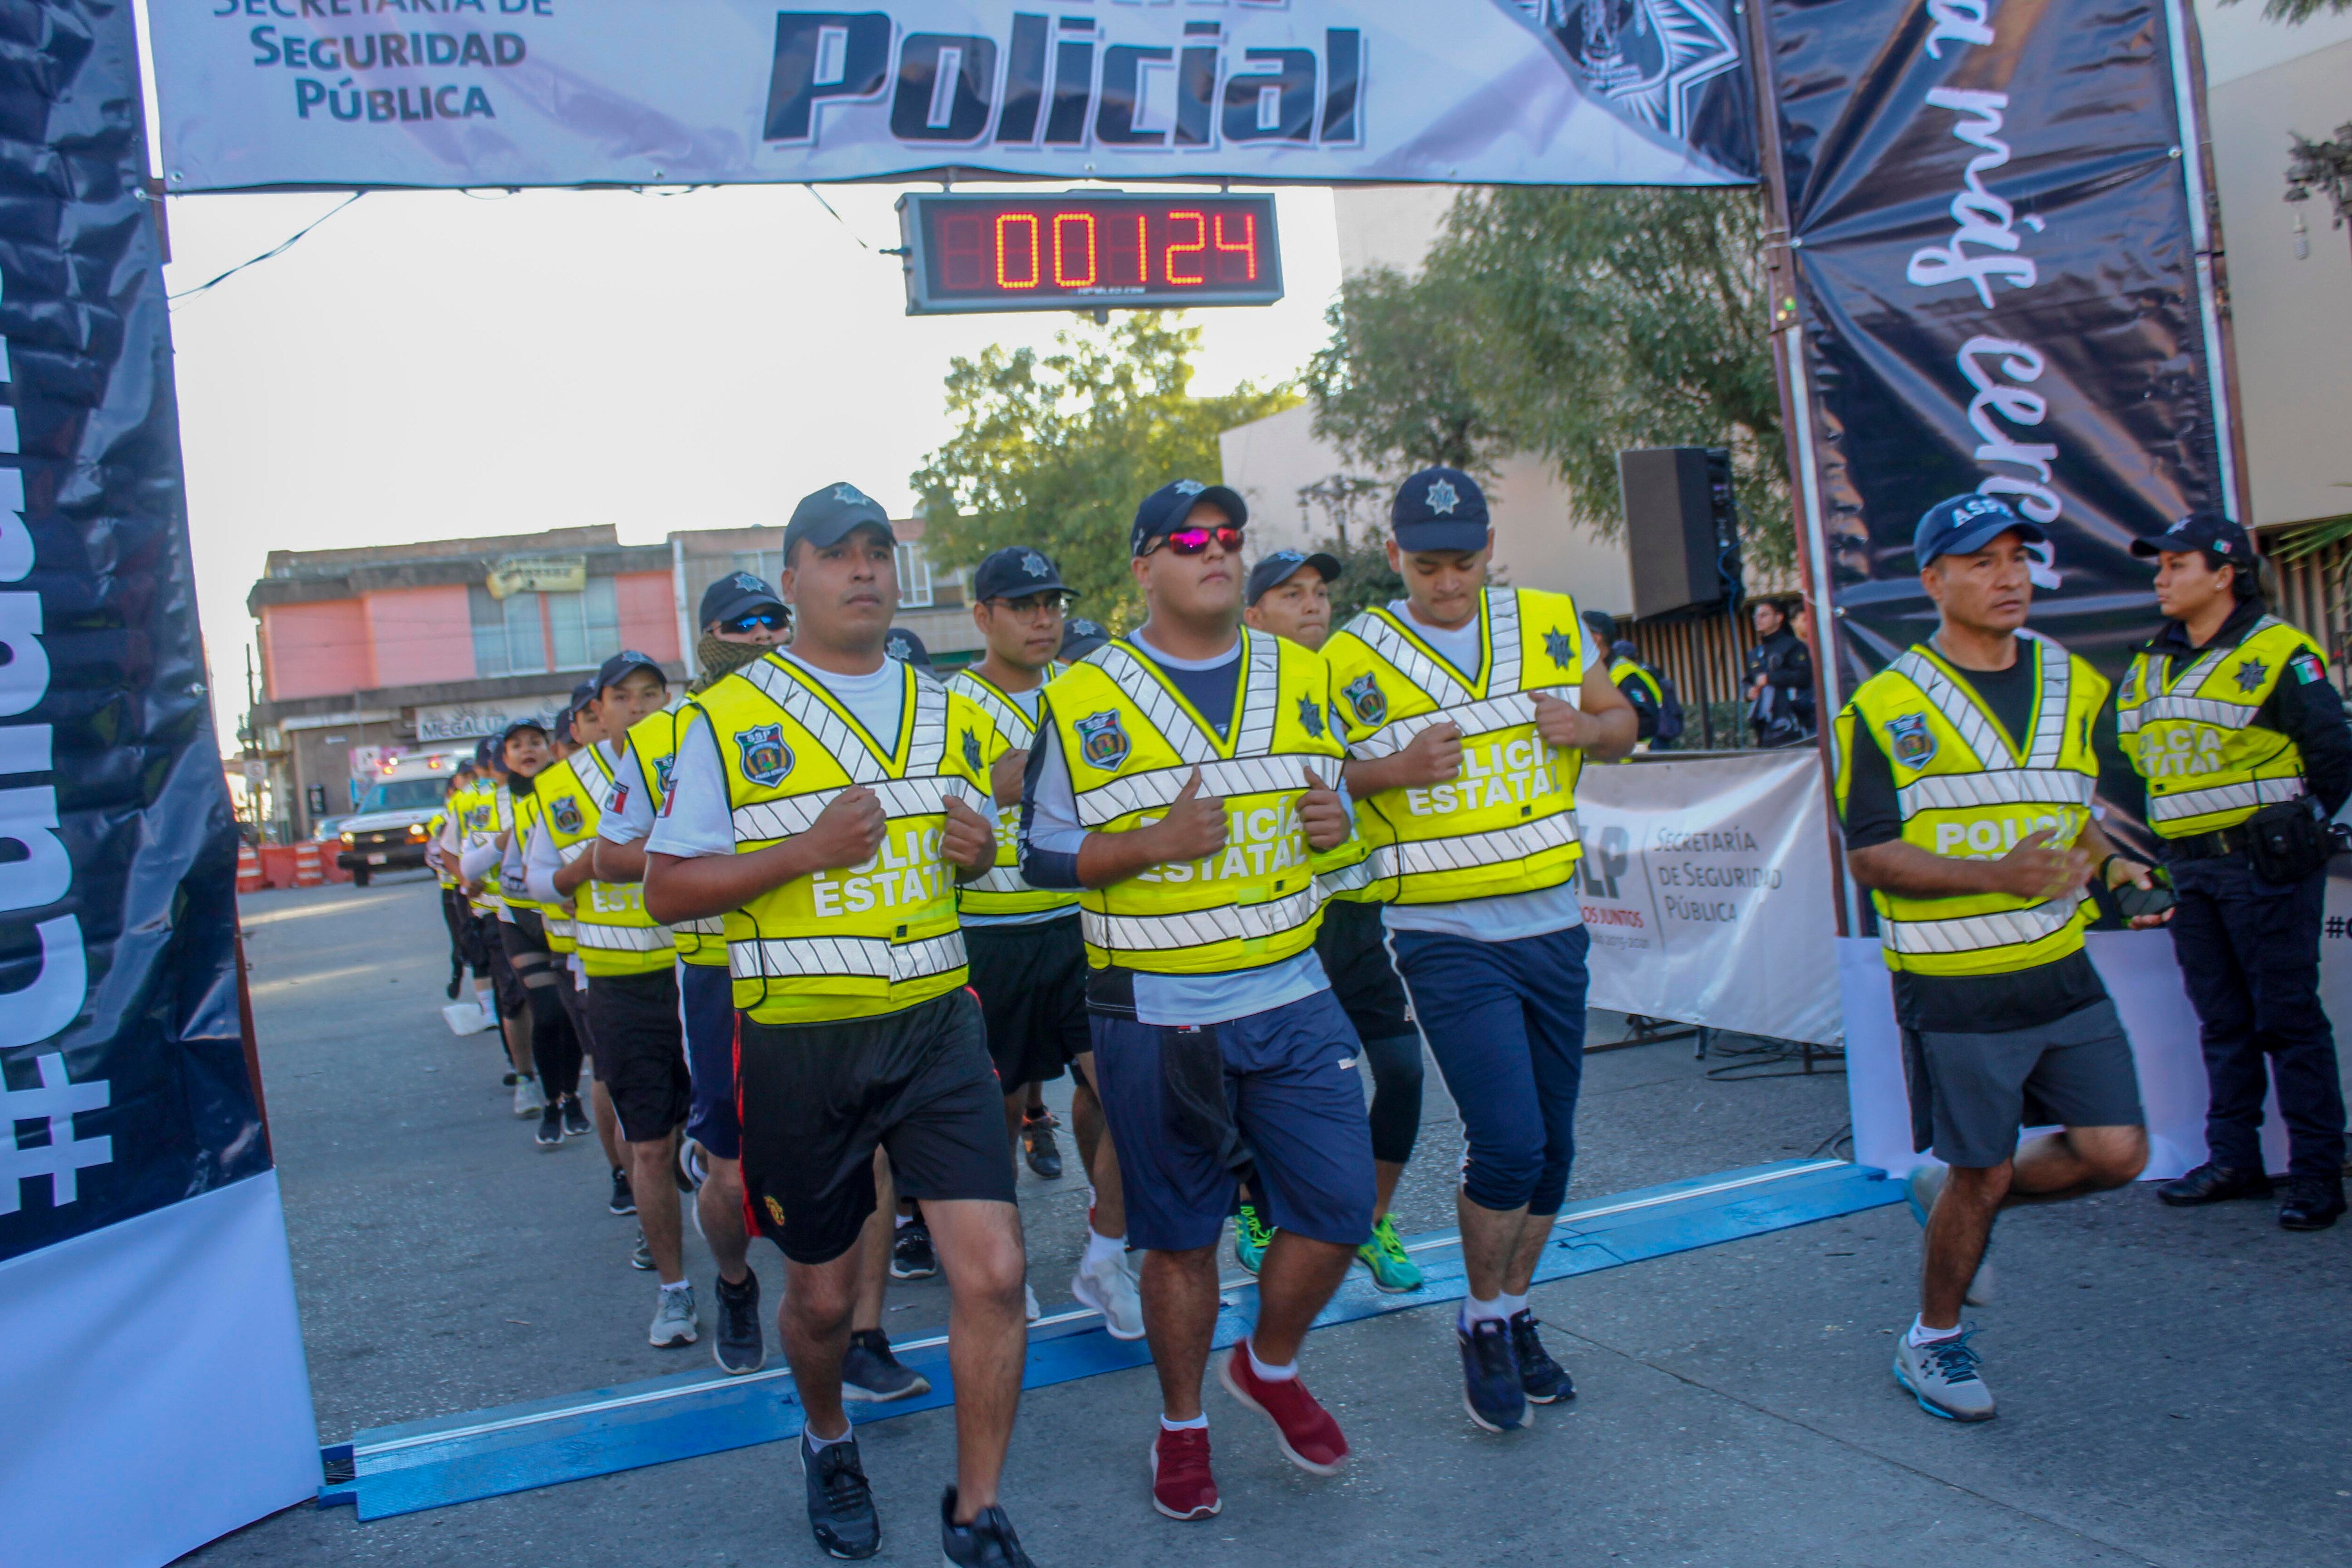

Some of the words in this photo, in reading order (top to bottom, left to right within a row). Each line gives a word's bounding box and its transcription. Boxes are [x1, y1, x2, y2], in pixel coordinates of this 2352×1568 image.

[250, 25, 527, 71] SEGURIDAD
[294, 77, 496, 123] PÚBLICA
[763, 10, 1364, 147] Policial
[1406, 765, 1563, 816] ESTATAL
[1658, 867, 1681, 886] DE
[1664, 894, 1738, 923] PÚBLICA
